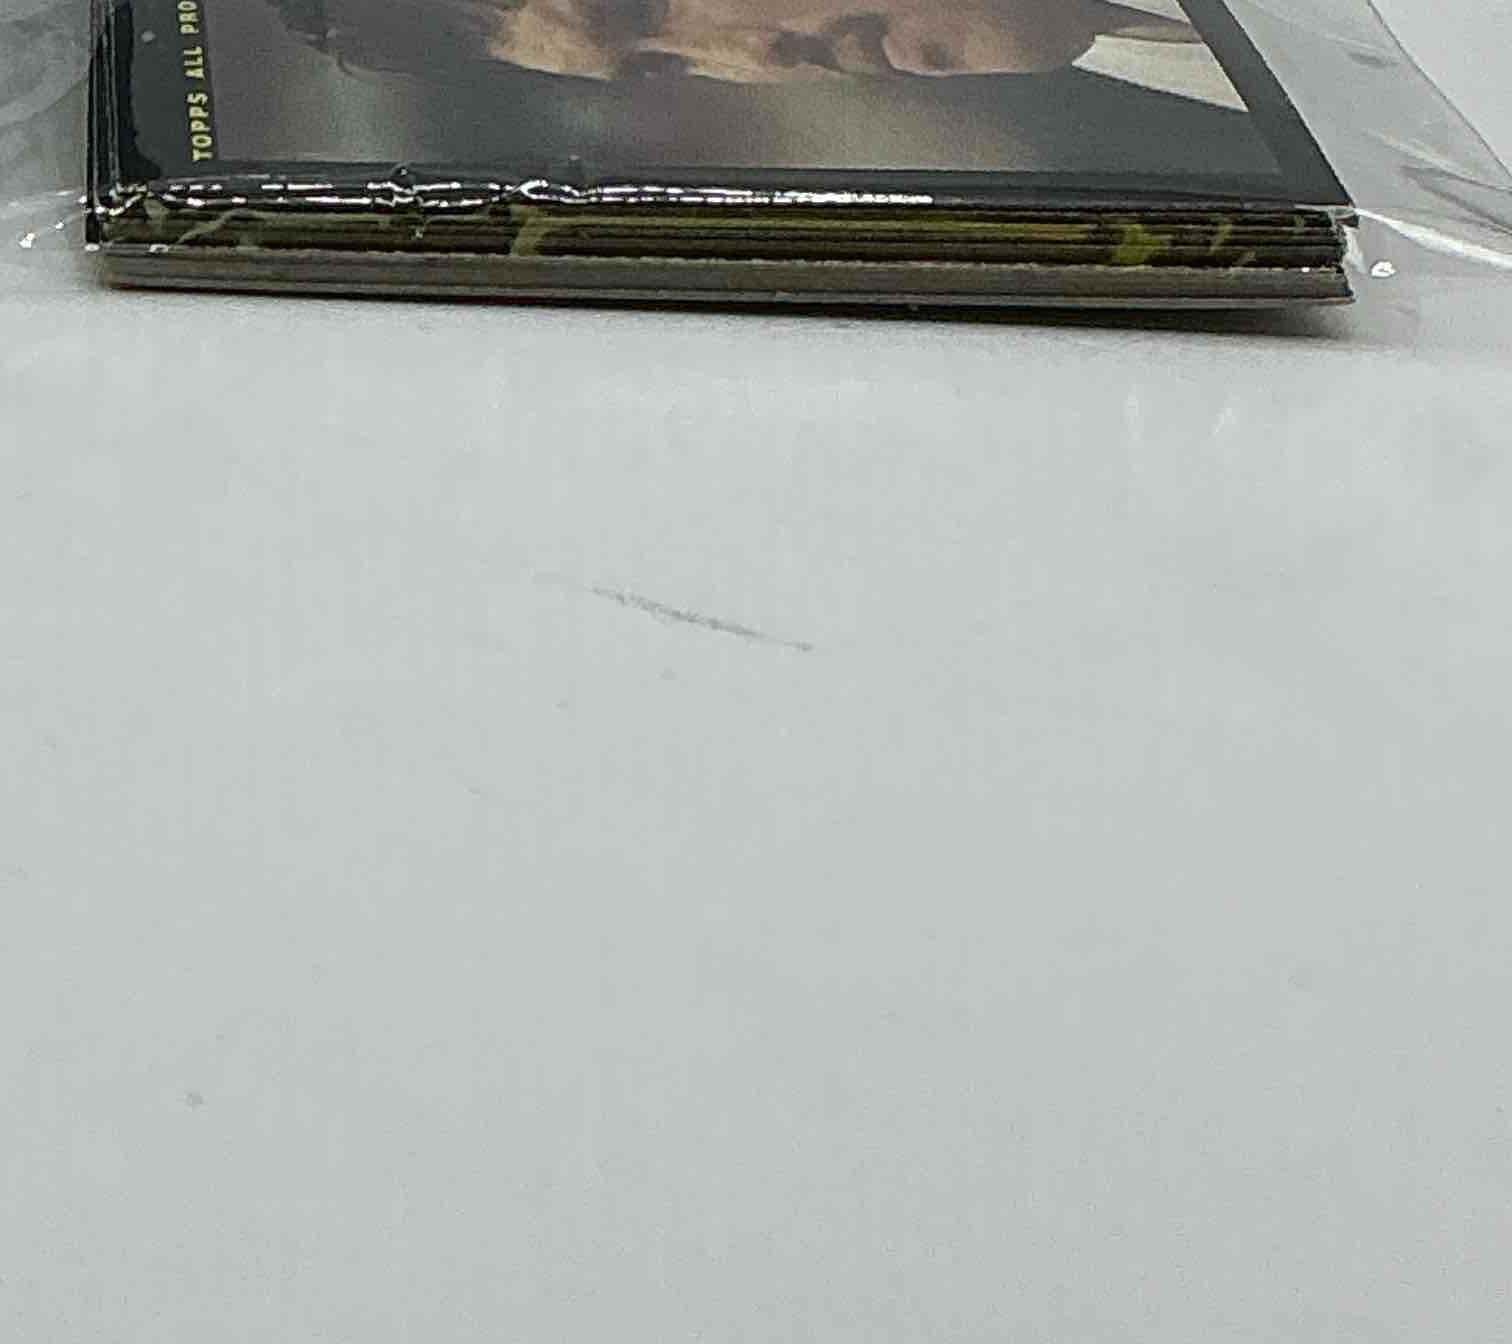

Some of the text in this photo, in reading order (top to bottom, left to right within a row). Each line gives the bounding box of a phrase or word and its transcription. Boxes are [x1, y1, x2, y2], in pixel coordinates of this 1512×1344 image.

[177, 0, 213, 162] TOPPS ALL PRO
